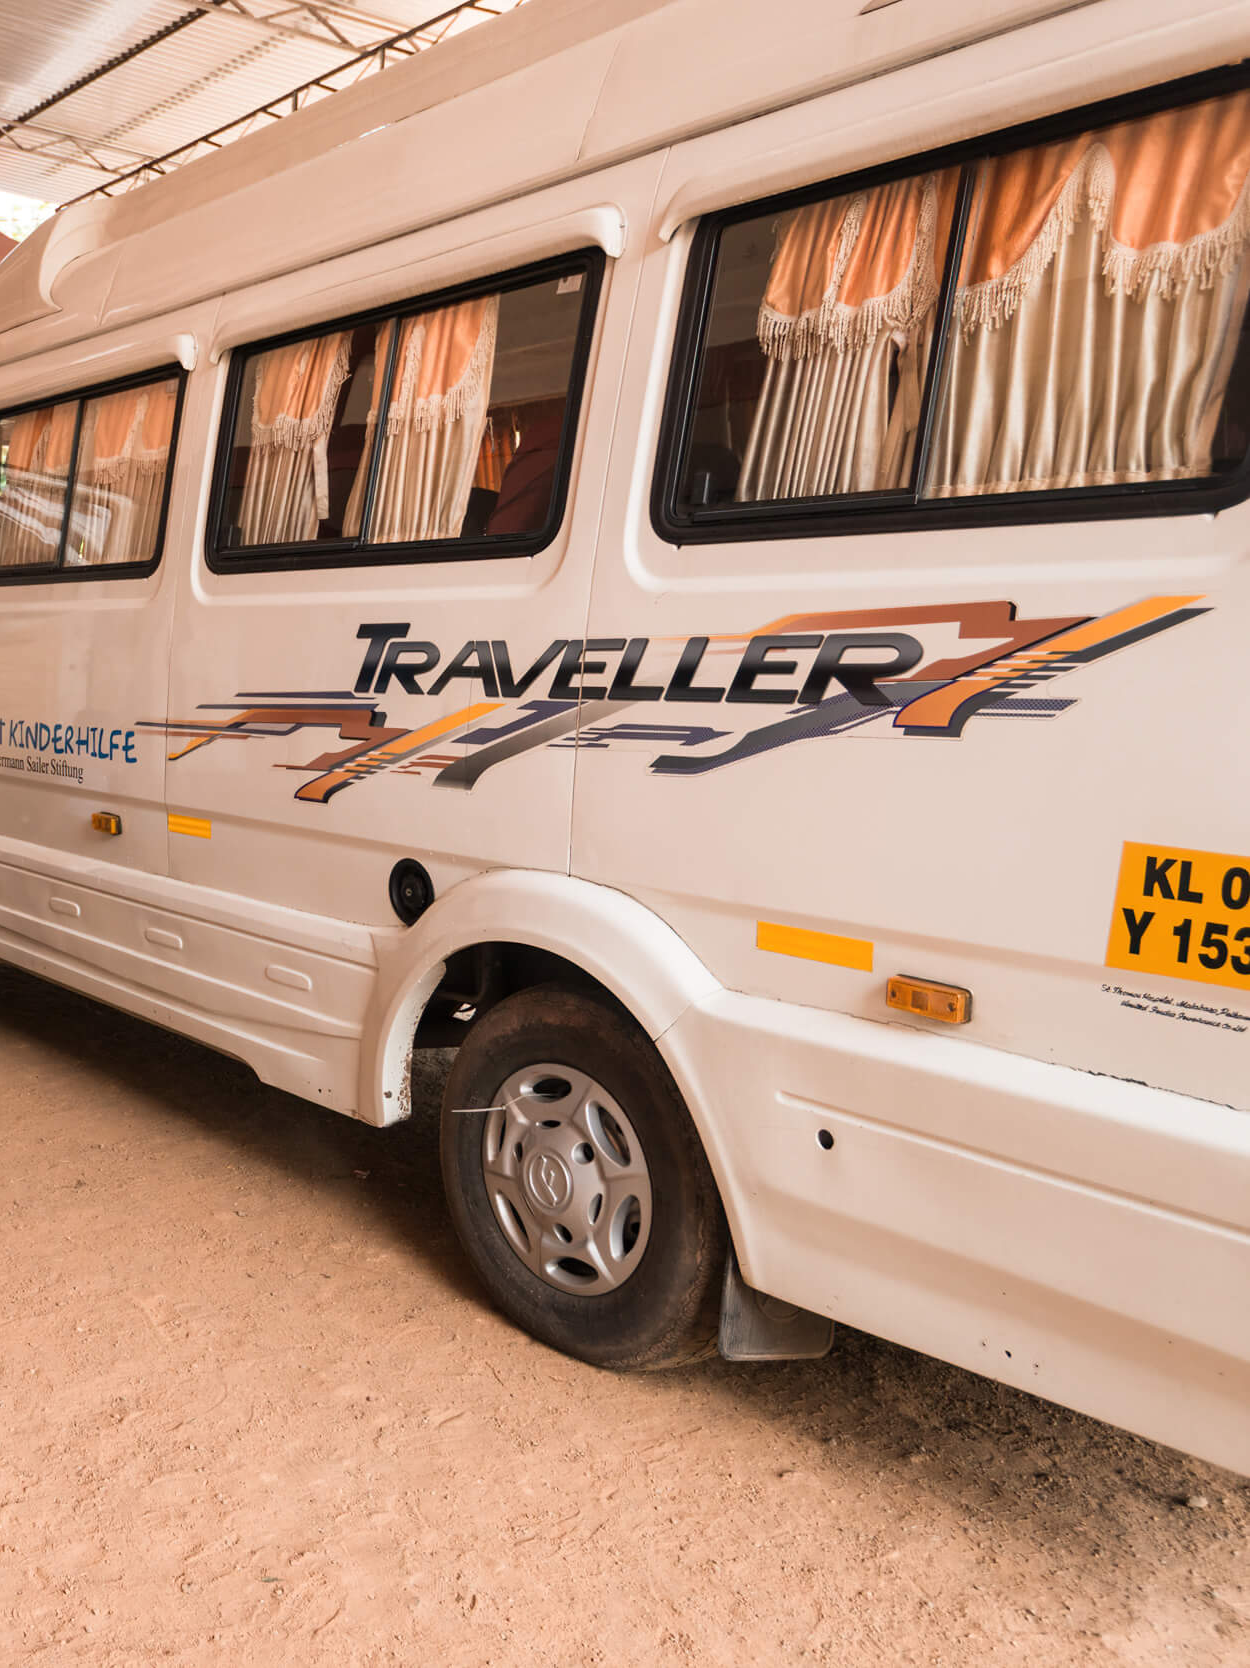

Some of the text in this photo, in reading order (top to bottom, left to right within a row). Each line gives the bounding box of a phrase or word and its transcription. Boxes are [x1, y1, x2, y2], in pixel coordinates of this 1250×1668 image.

[354, 623, 924, 706] TRAVELLER
[8, 719, 138, 764] KINDERHILFE
[26, 755, 50, 775] Sailer
[50, 758, 84, 784] Stiftung
[1143, 855, 1250, 910] KL 0
[1122, 907, 1156, 955] Y
